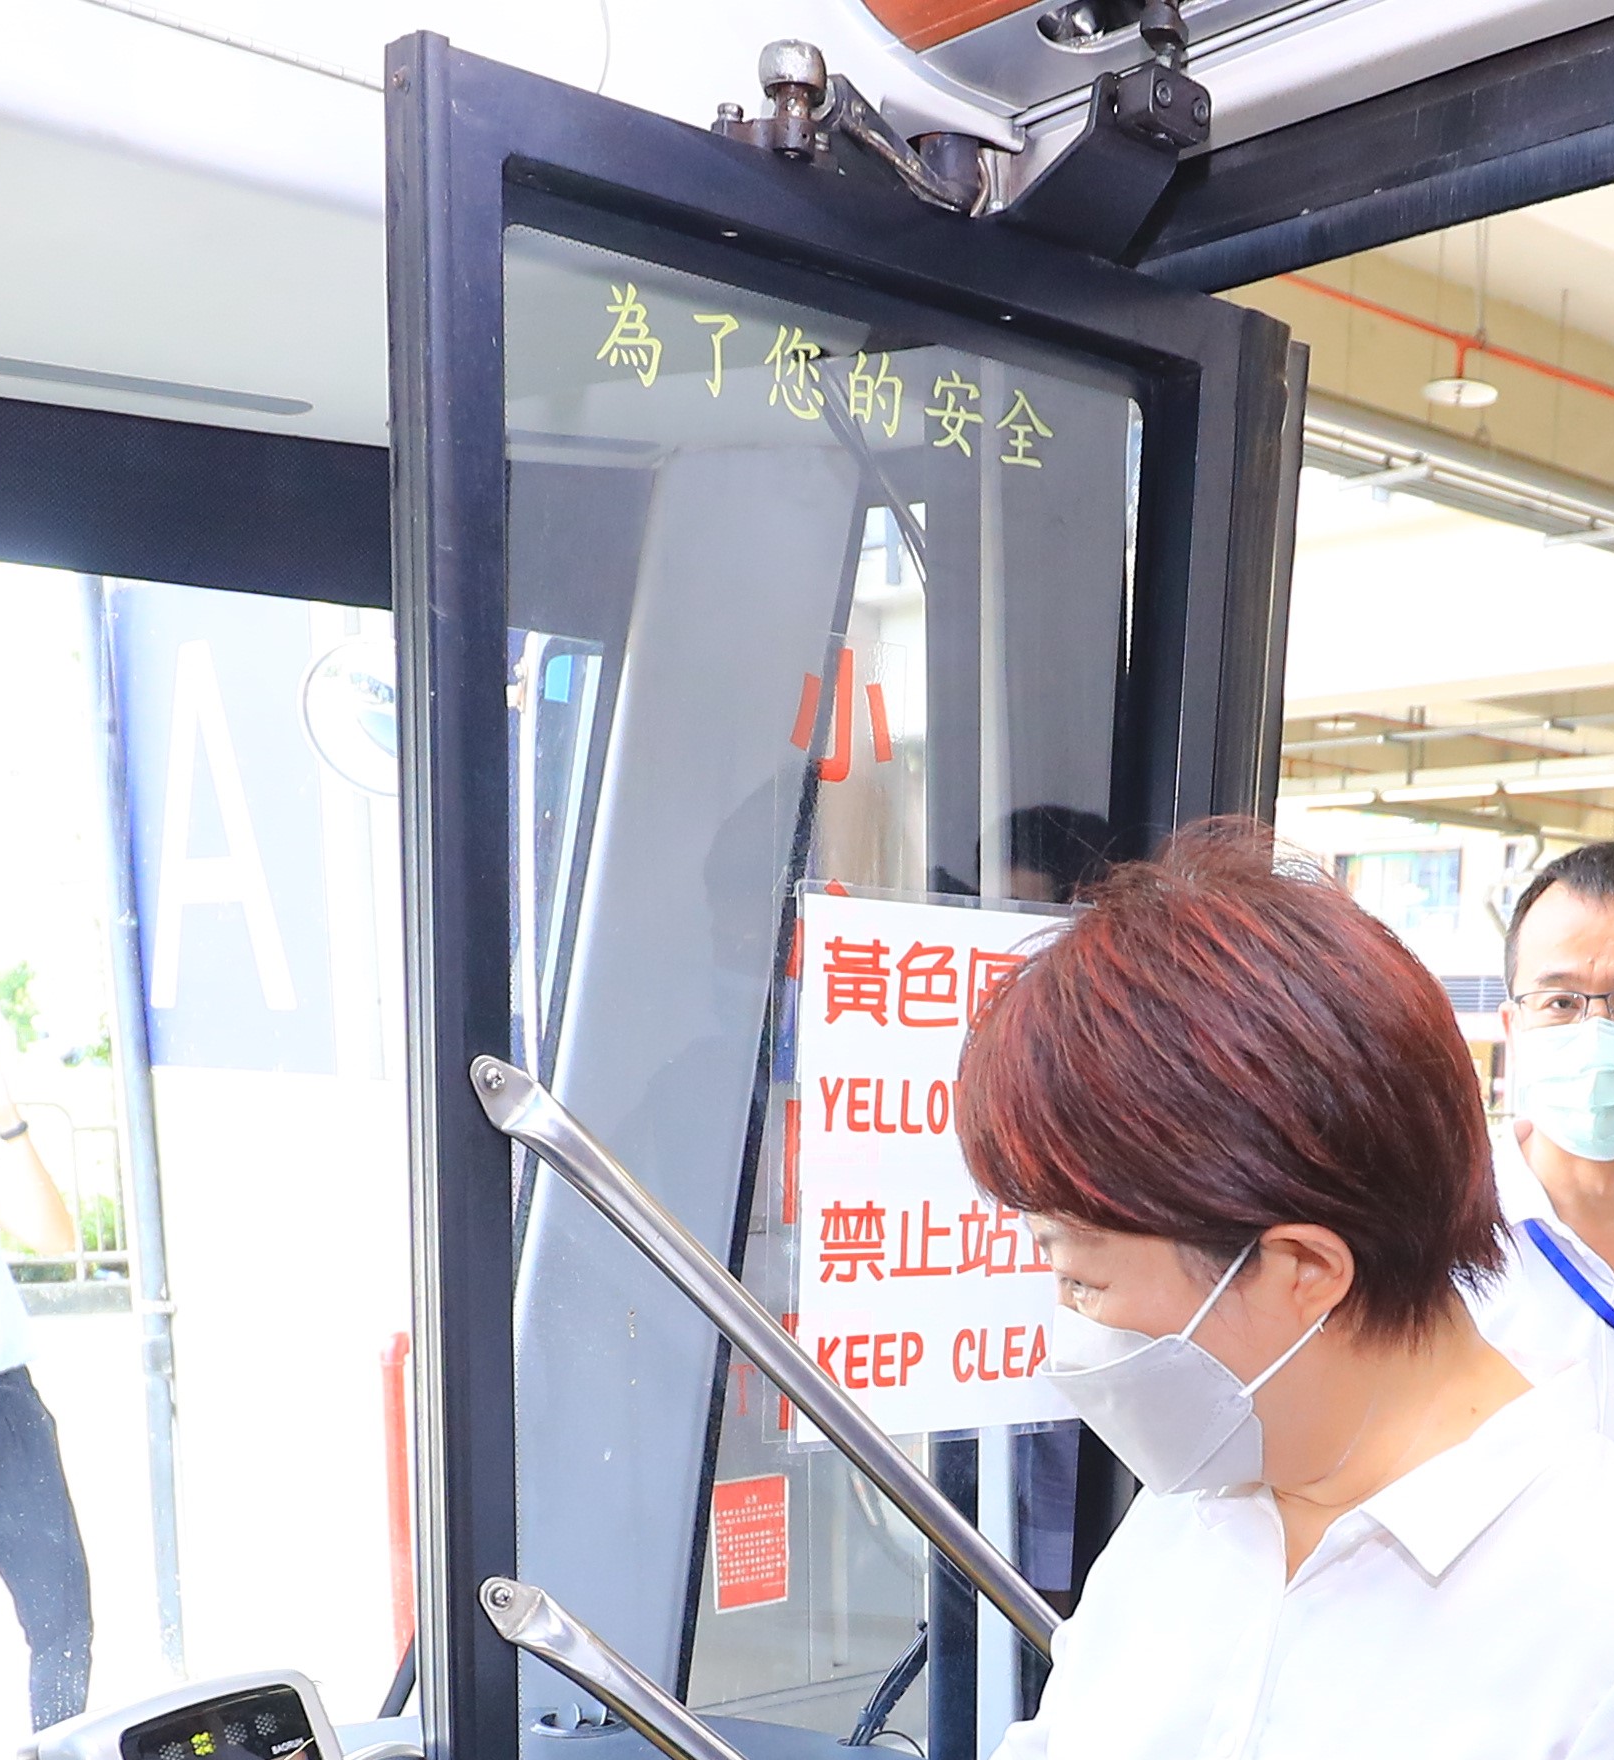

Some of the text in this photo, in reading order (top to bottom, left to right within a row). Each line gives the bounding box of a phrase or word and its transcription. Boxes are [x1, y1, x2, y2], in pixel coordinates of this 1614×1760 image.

[596, 282, 1054, 469] 為了您的安全
[149, 637, 300, 1011] A
[819, 1076, 960, 1135] YELLO
[817, 1331, 923, 1391] KEEP
